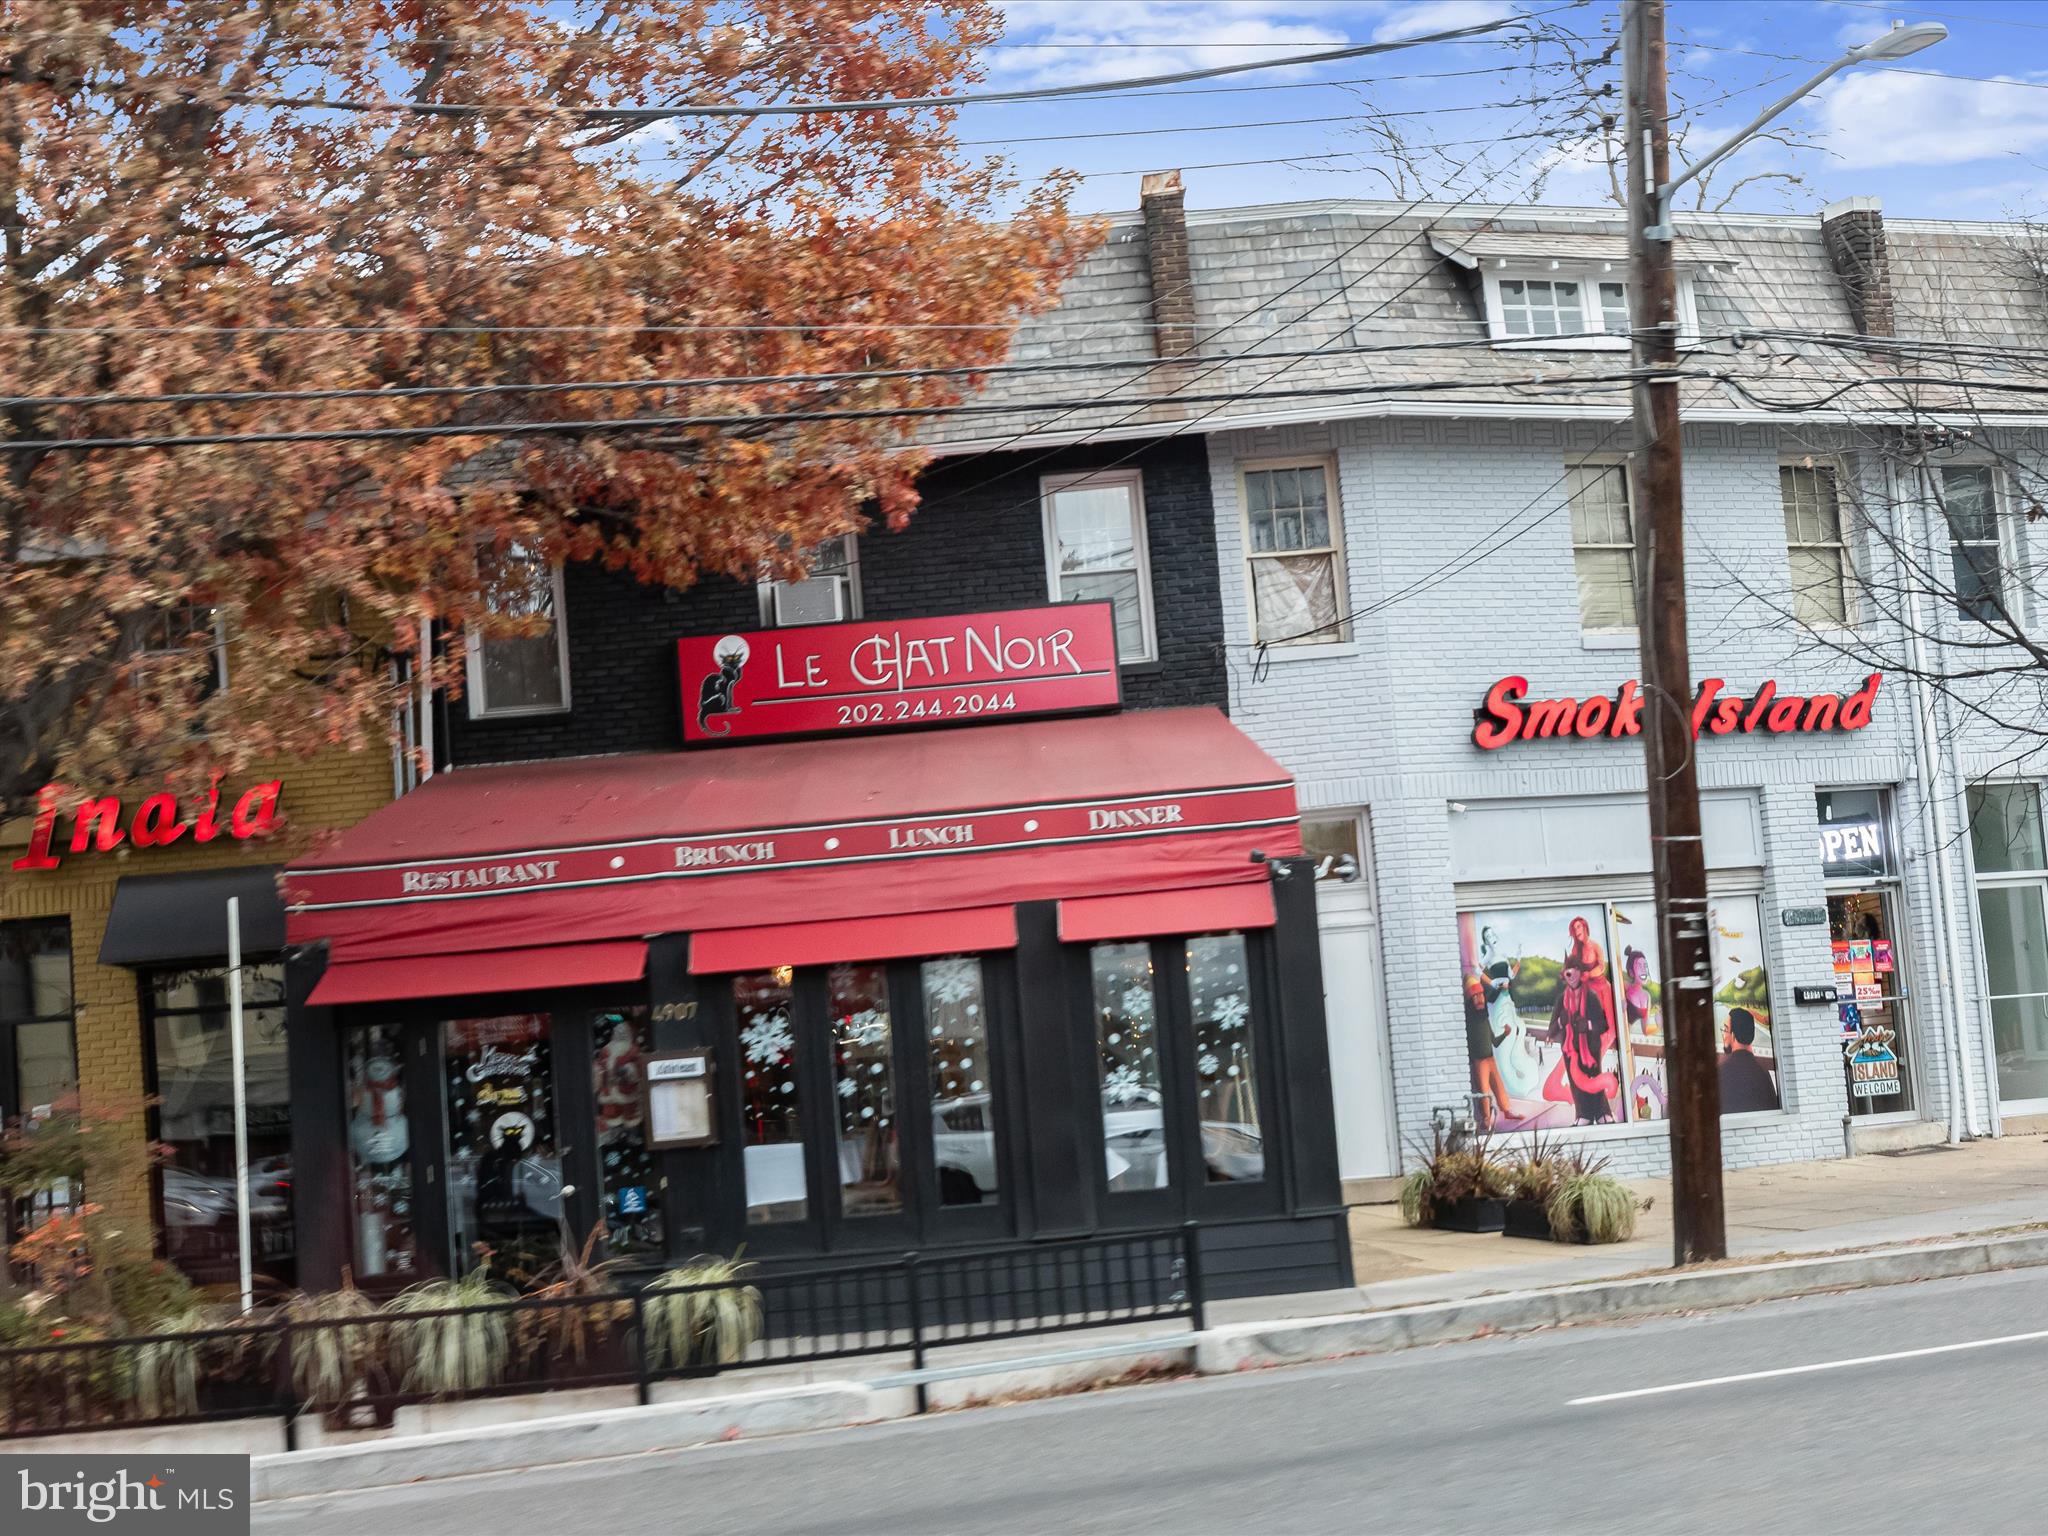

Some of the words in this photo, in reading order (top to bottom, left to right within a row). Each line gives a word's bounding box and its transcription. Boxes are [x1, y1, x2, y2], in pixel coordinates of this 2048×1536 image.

[850, 631, 956, 692] CHAT
[965, 625, 1082, 674] NOIR
[837, 691, 1017, 726] 202.244.2044
[1473, 675, 1646, 751] Smok
[1692, 672, 1882, 742] Island
[401, 861, 560, 894] RESTAURANT
[674, 841, 775, 868] BRUNCH
[888, 824, 975, 849] LUNCH
[1088, 804, 1185, 831] DINNER
[1854, 1061, 1897, 1081] ISLAND
[1854, 1081, 1900, 1096] WELCOME
